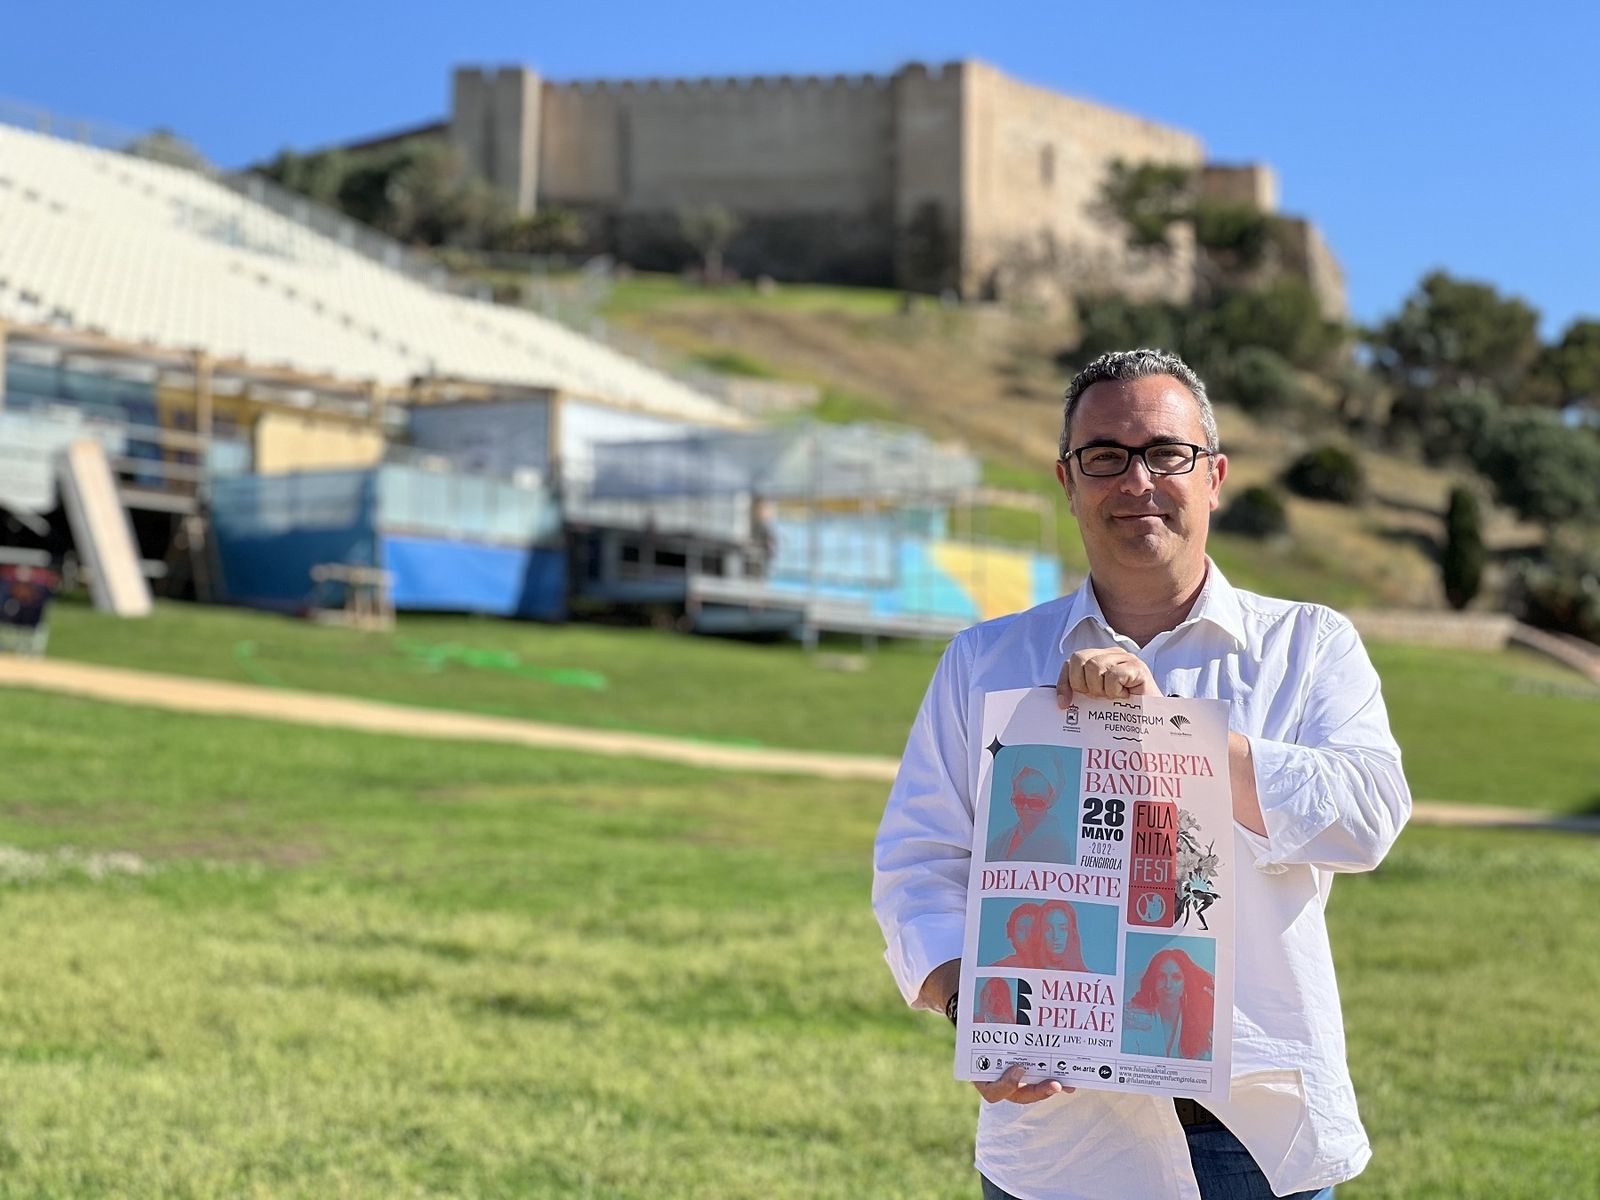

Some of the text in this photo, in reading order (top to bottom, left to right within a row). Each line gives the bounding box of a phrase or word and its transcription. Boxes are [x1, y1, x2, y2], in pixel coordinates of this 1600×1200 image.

[1088, 711, 1164, 726] MARENOSTRUM
[1086, 748, 1214, 777] RIGOBERTA
[1085, 772, 1182, 798] BANDINI
[1082, 797, 1126, 828] 28
[1136, 804, 1173, 830] FULA
[1081, 826, 1124, 842] MAYO
[1135, 831, 1172, 857] NITA
[1080, 855, 1122, 871] FUENGIROLA
[1133, 857, 1172, 883] FEST
[981, 869, 1121, 898] DELAPORTE
[1042, 979, 1115, 1006] MARÍA
[1037, 1005, 1115, 1033] PELÁE
[972, 1030, 1019, 1045] ROCIO
[1024, 1033, 1061, 1048] SAIZ
[1063, 1035, 1082, 1045] LIVE
[1088, 1038, 1098, 1046] DJ
[1098, 1039, 1113, 1048] SET
